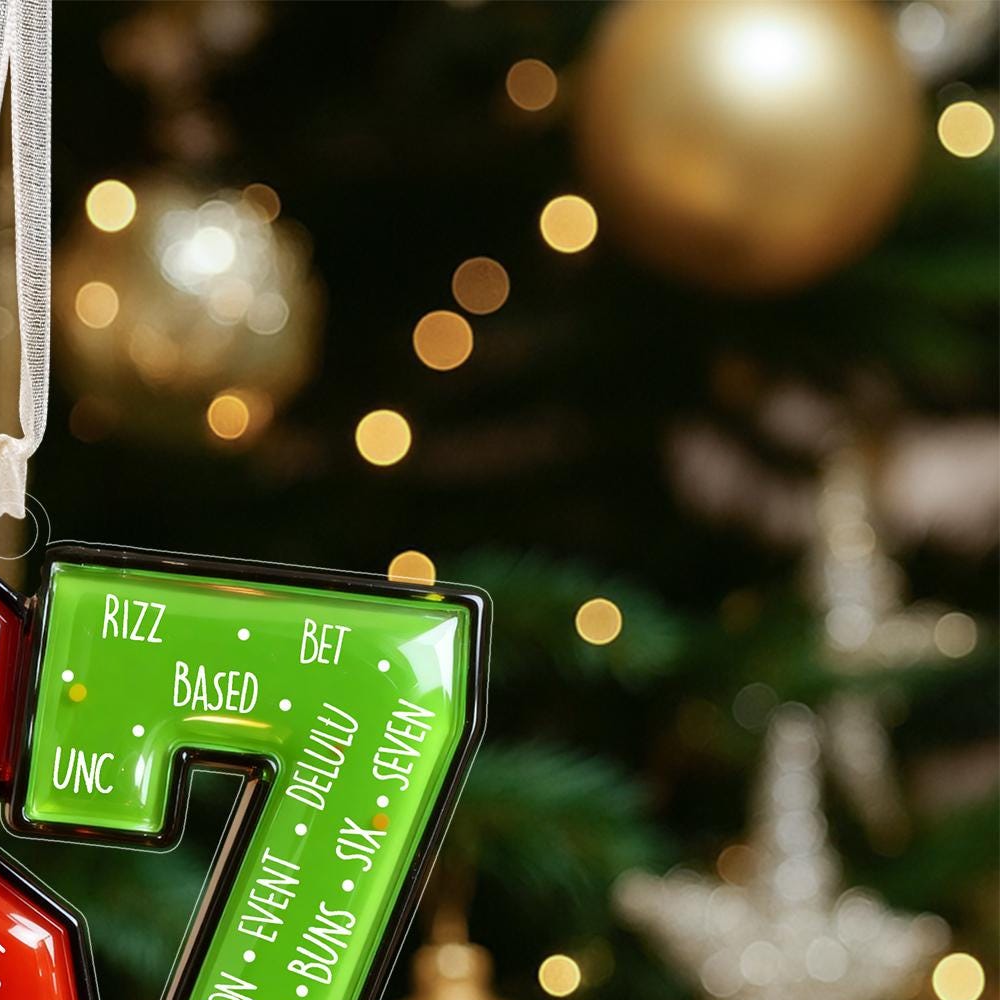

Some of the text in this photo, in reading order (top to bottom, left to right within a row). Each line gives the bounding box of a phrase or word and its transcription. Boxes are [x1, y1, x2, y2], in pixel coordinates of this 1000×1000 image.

[102, 594, 167, 644] RIZZ
[300, 618, 352, 665] BET
[173, 661, 259, 714] BASED
[52, 746, 115, 794] UNC
[237, 847, 302, 943] EVENT
[285, 702, 359, 811] DELULU
[287, 901, 357, 986] BUNS
[336, 817, 388, 873] SIX
[372, 698, 436, 791] SEVEN
